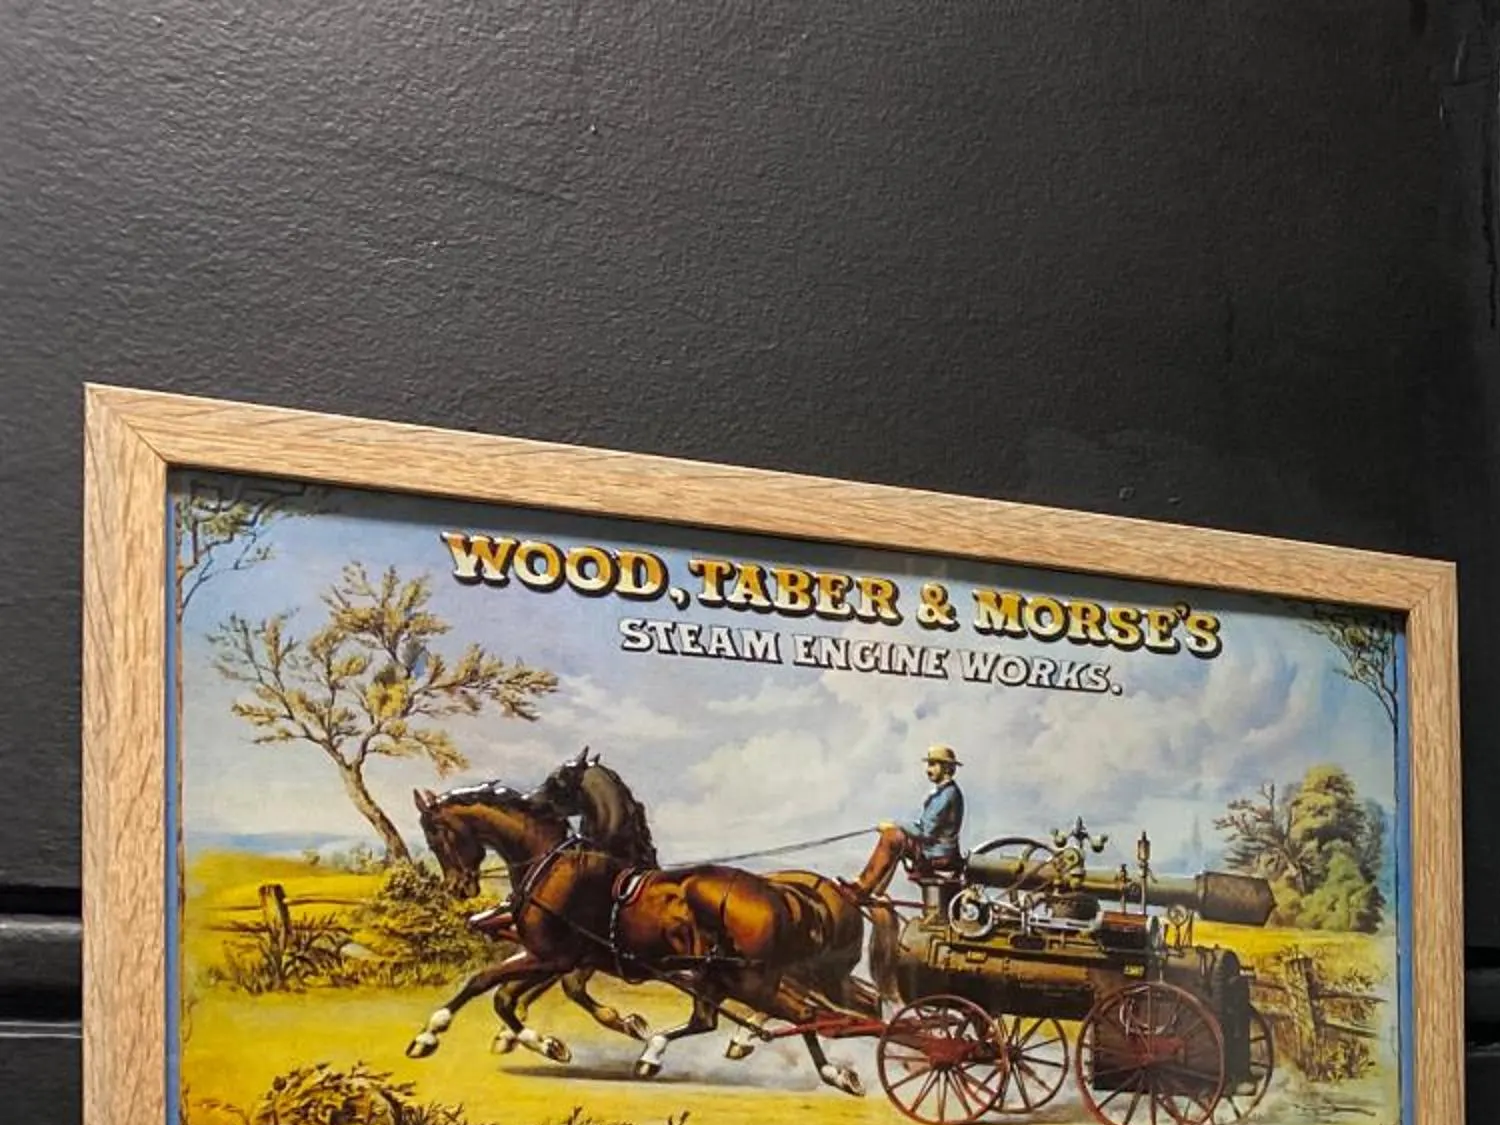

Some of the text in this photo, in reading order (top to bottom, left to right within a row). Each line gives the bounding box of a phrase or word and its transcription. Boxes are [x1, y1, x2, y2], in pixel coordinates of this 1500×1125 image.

[690, 559, 903, 627] TABER
[916, 583, 960, 630] &
[618, 618, 1124, 697] STEAM ENGINE WORKS.
